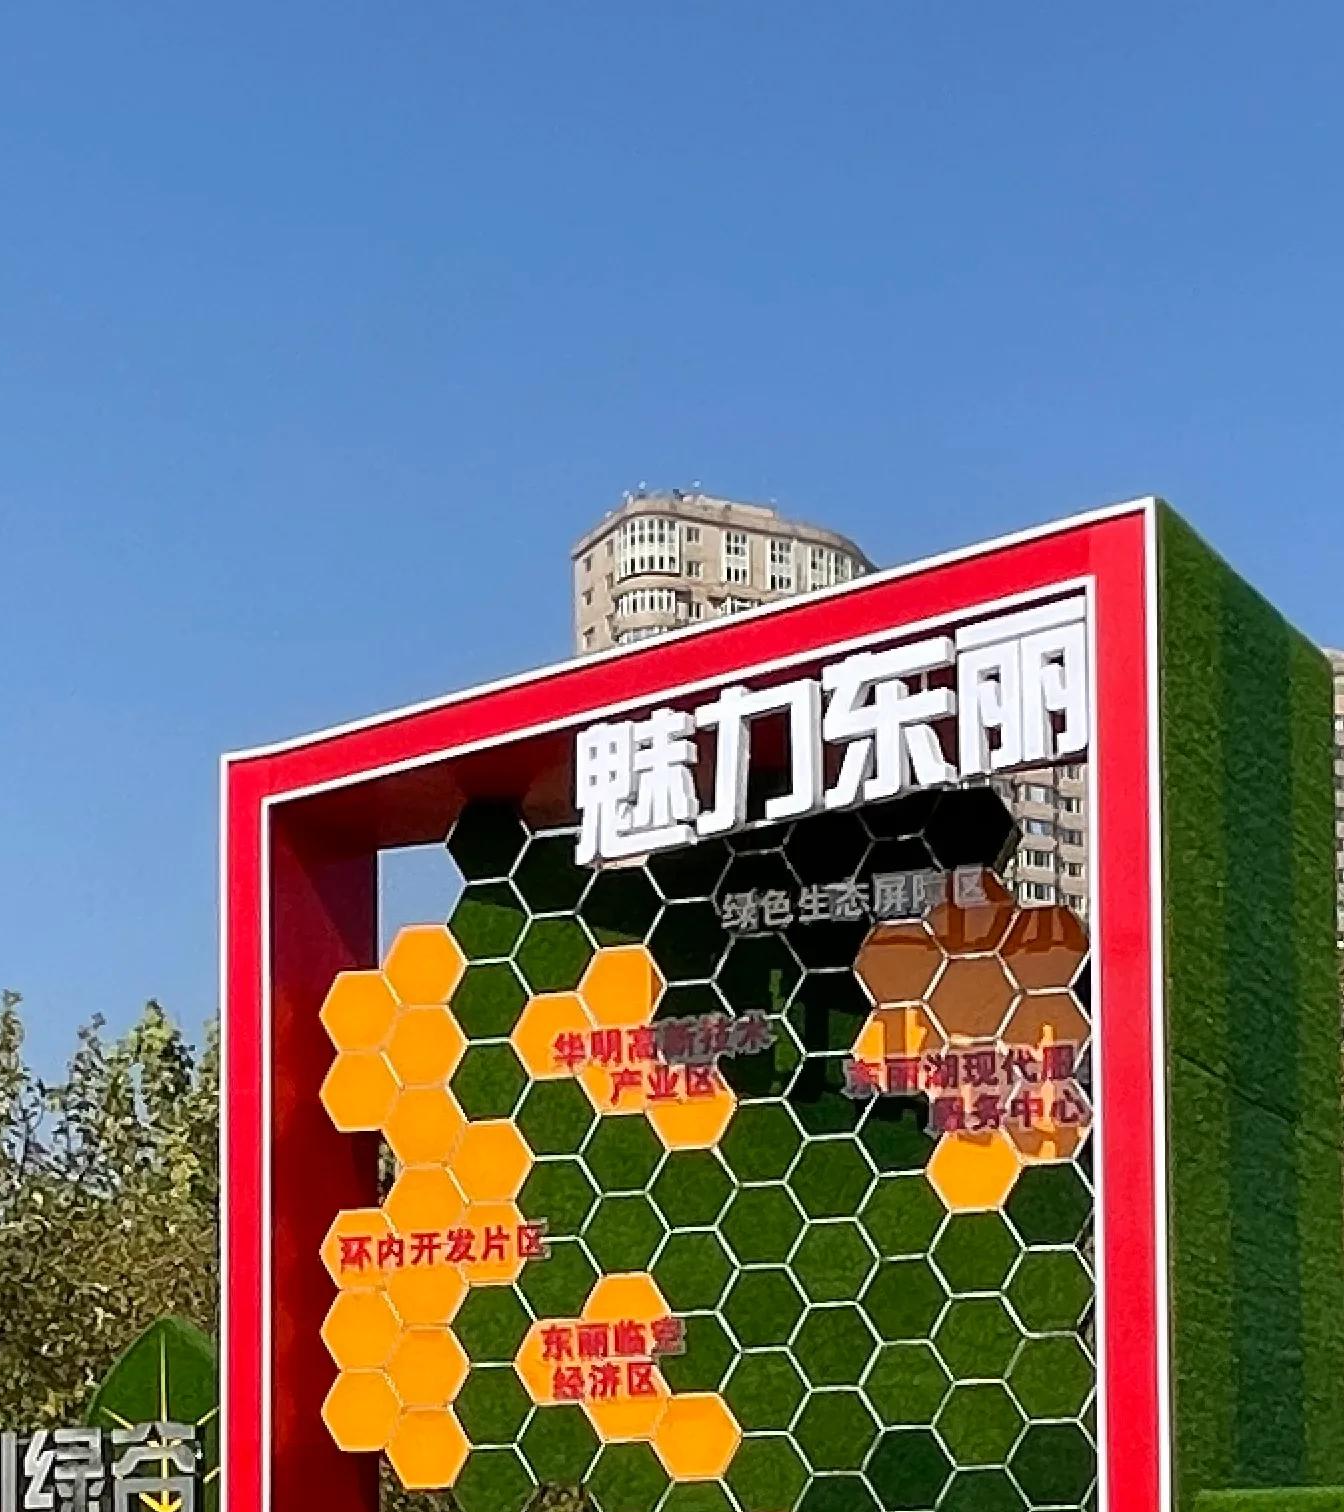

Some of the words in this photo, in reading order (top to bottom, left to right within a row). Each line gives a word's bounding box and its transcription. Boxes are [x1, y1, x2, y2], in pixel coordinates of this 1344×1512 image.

[574, 594, 1089, 867] 魅力东丽
[610, 1064, 719, 1105] 产业区
[338, 1222, 544, 1273] 环内开发片区
[540, 1315, 688, 1361] 东丽临空
[553, 1362, 658, 1400] 经济区
